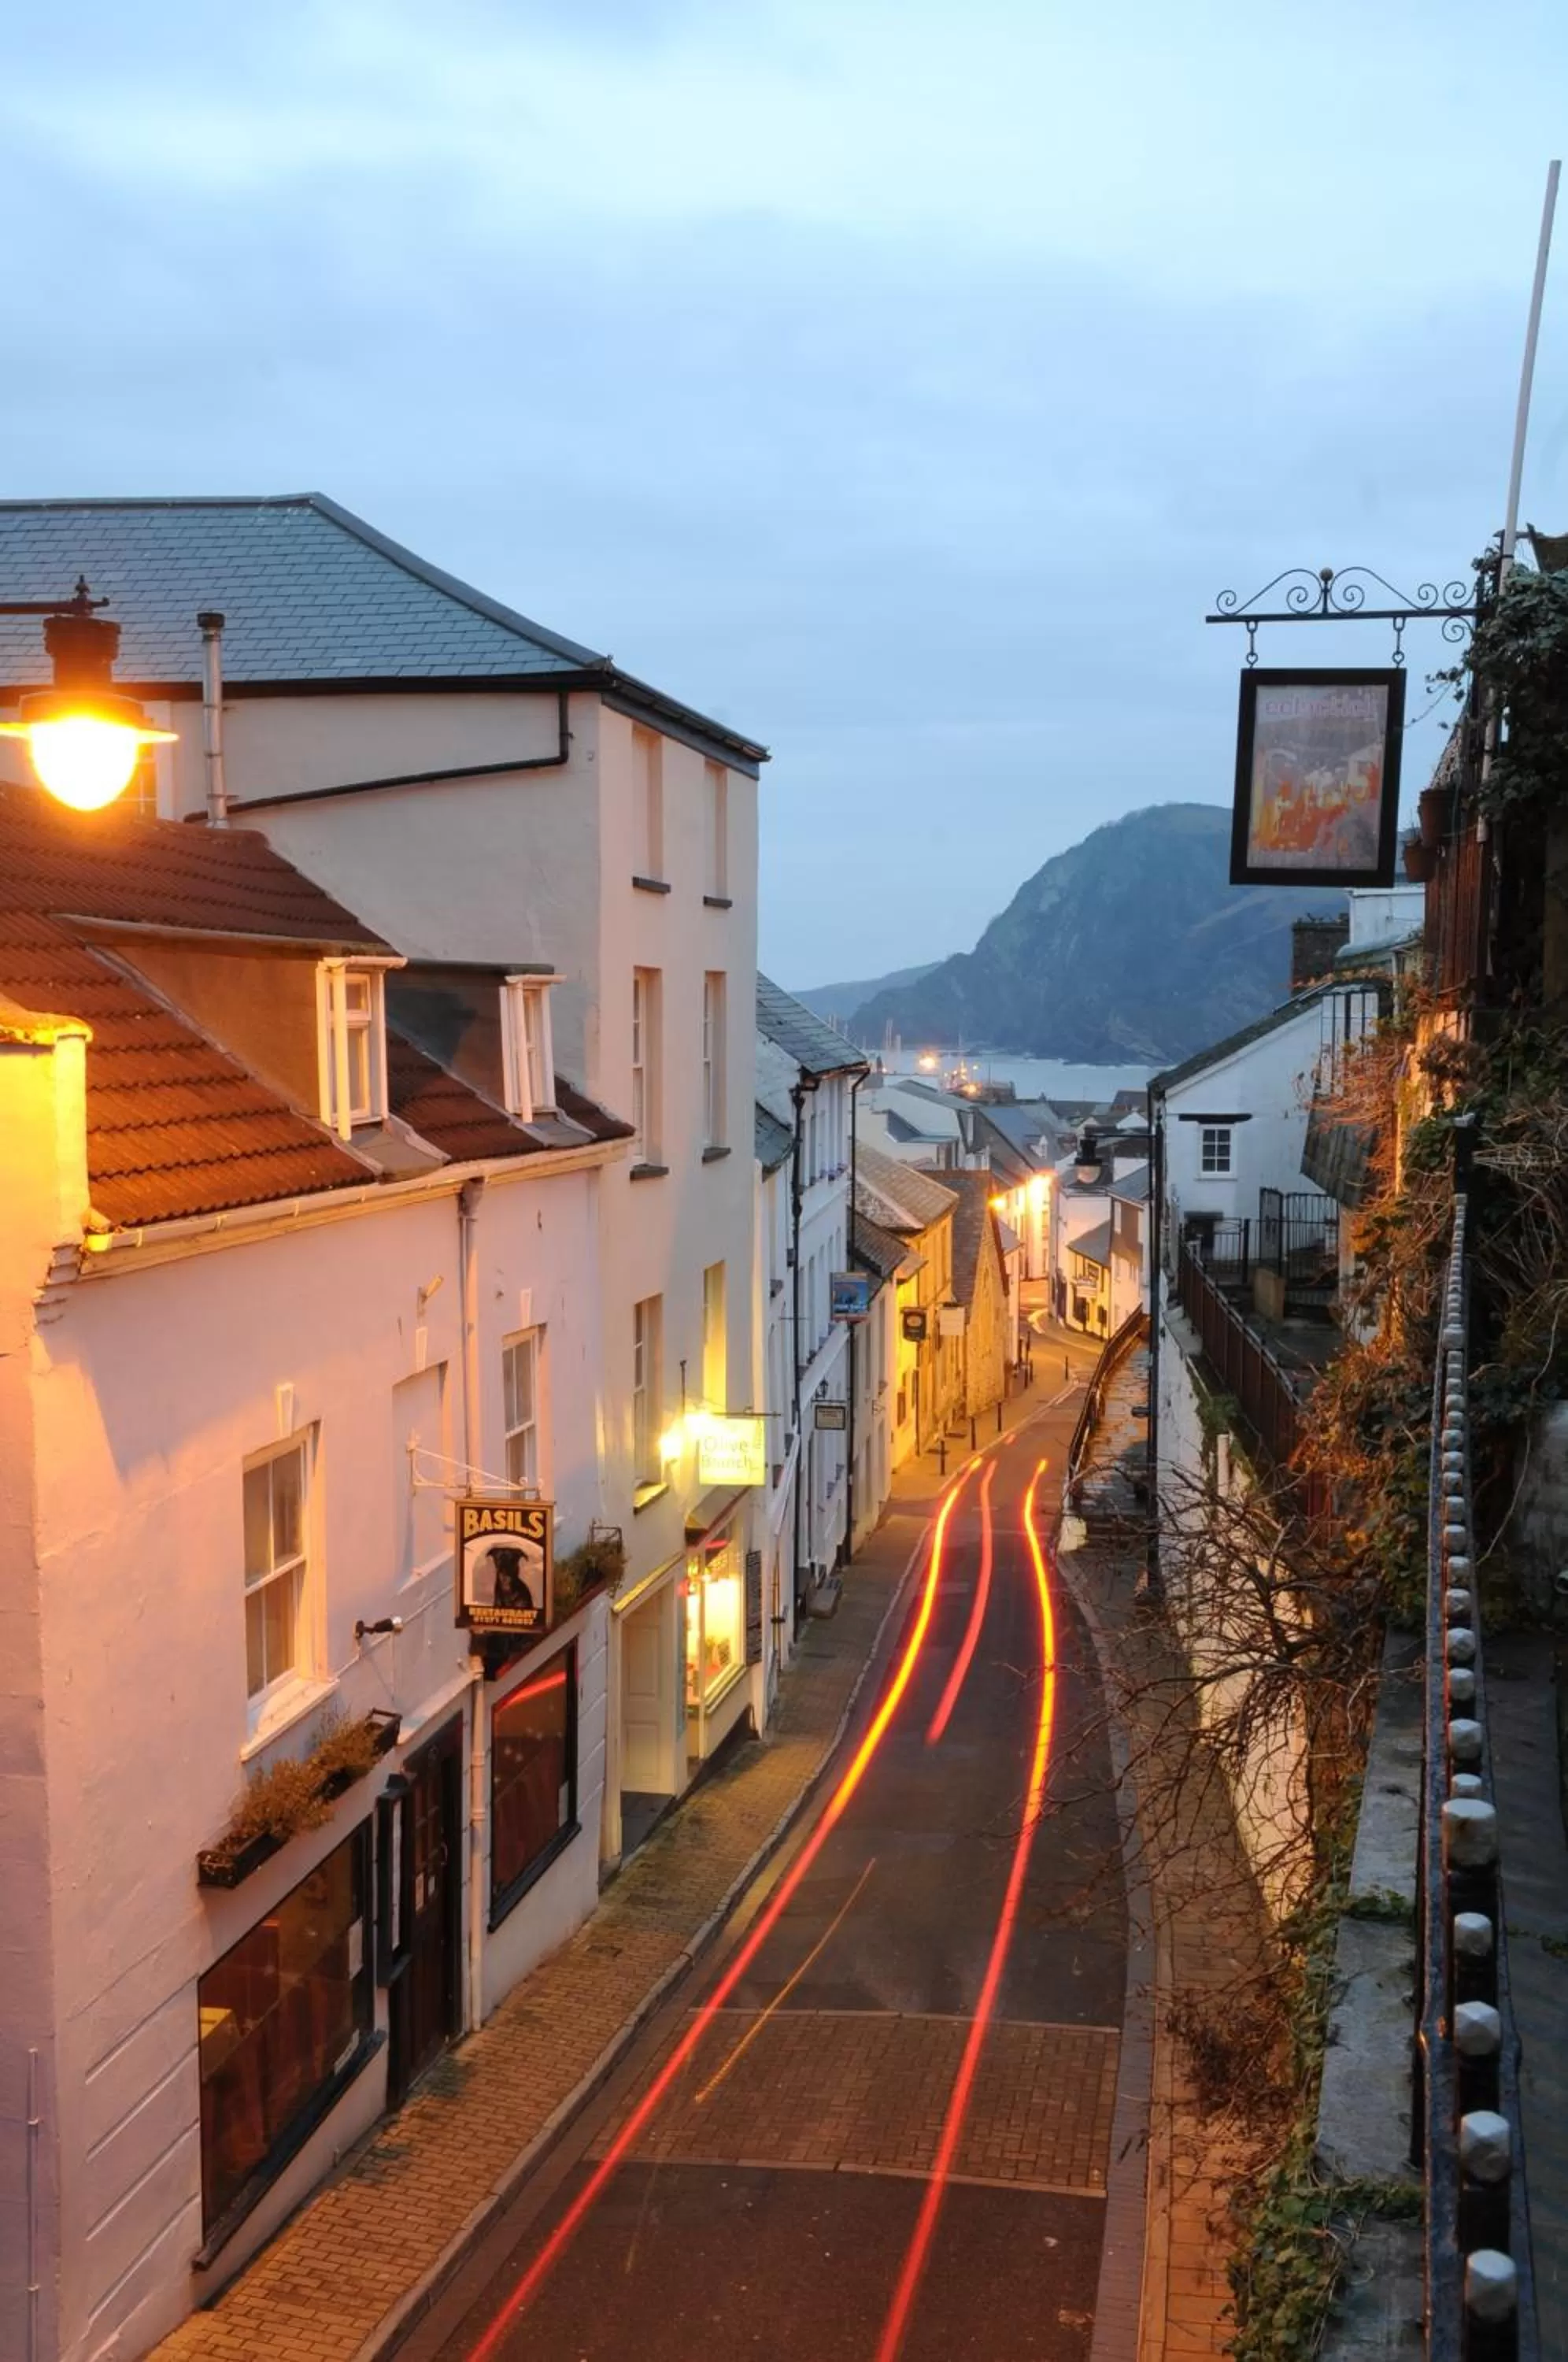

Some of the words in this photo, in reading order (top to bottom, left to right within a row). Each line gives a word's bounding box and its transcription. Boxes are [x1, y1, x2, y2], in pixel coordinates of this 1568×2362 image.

[704, 1435, 747, 1453] Olive
[464, 1509, 544, 1538] BASILS
[468, 1607, 538, 1620] RESTAURANT
